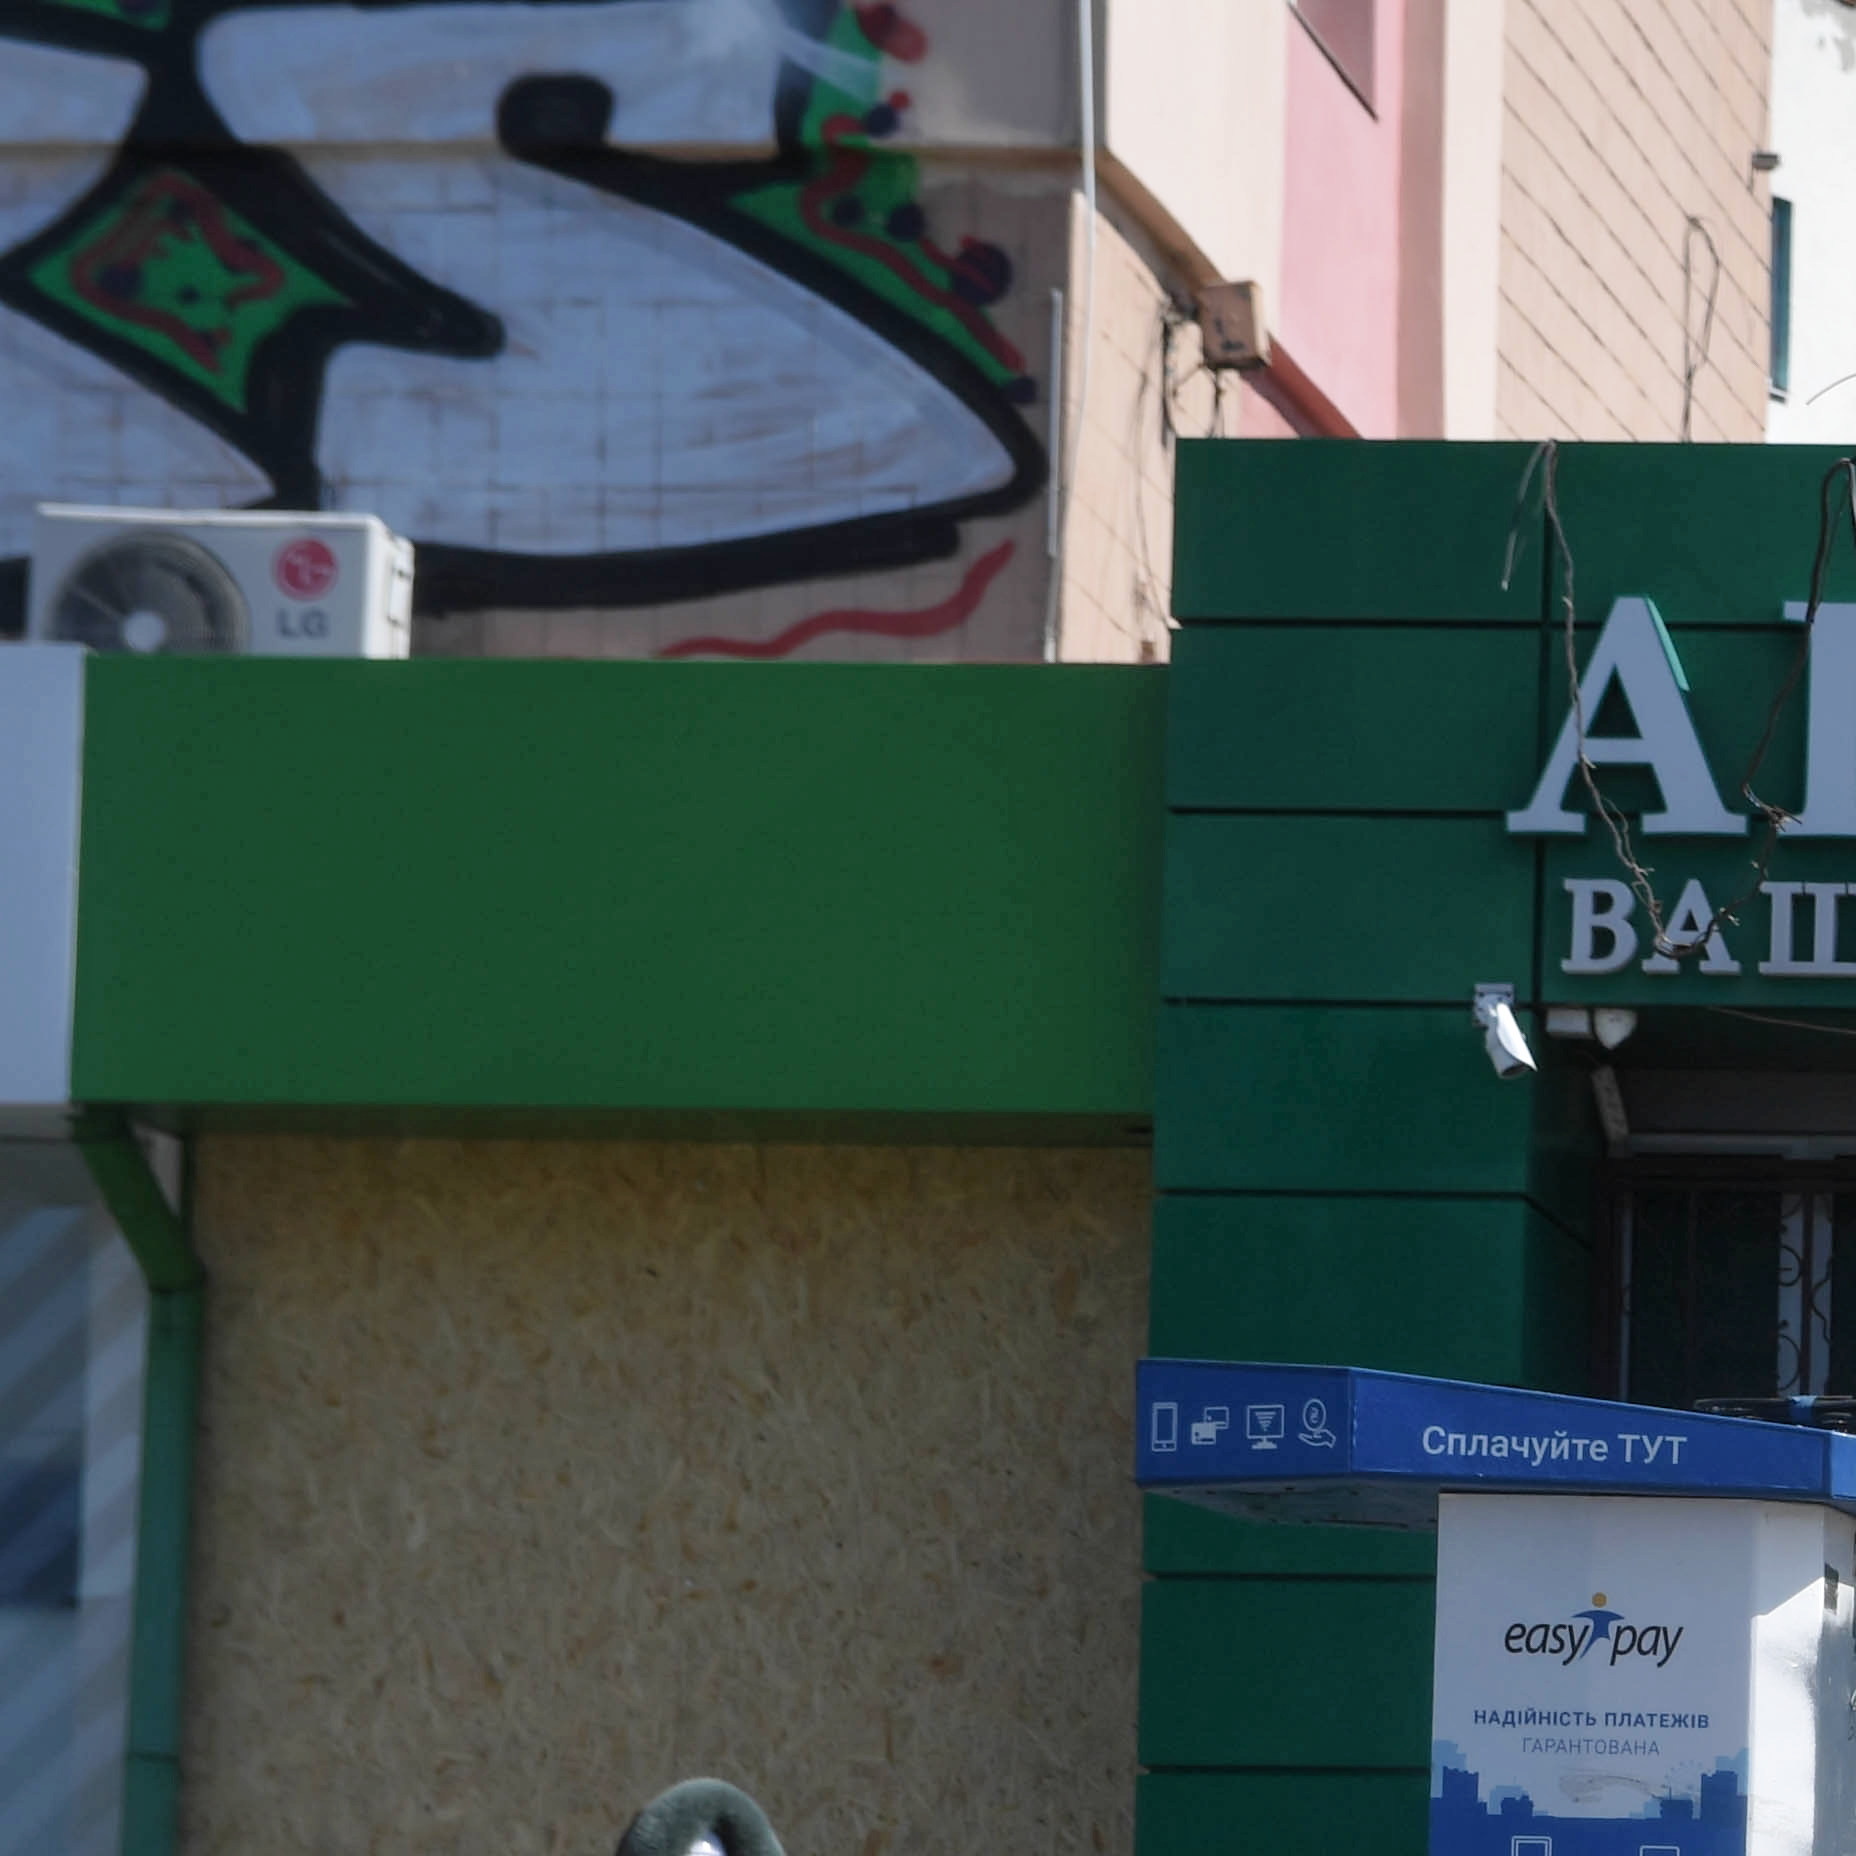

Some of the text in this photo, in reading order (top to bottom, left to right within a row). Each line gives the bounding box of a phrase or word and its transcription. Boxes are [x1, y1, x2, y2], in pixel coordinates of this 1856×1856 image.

[278, 607, 329, 640] LG
[1421, 1425, 1688, 1467] Сплачуйте ТУТ
[1473, 1707, 1710, 1730] НАДІЙНІСТЬ ПЛАТЕЖІВ
[1521, 1737, 1661, 1757] ГАРАНТОВАНА
